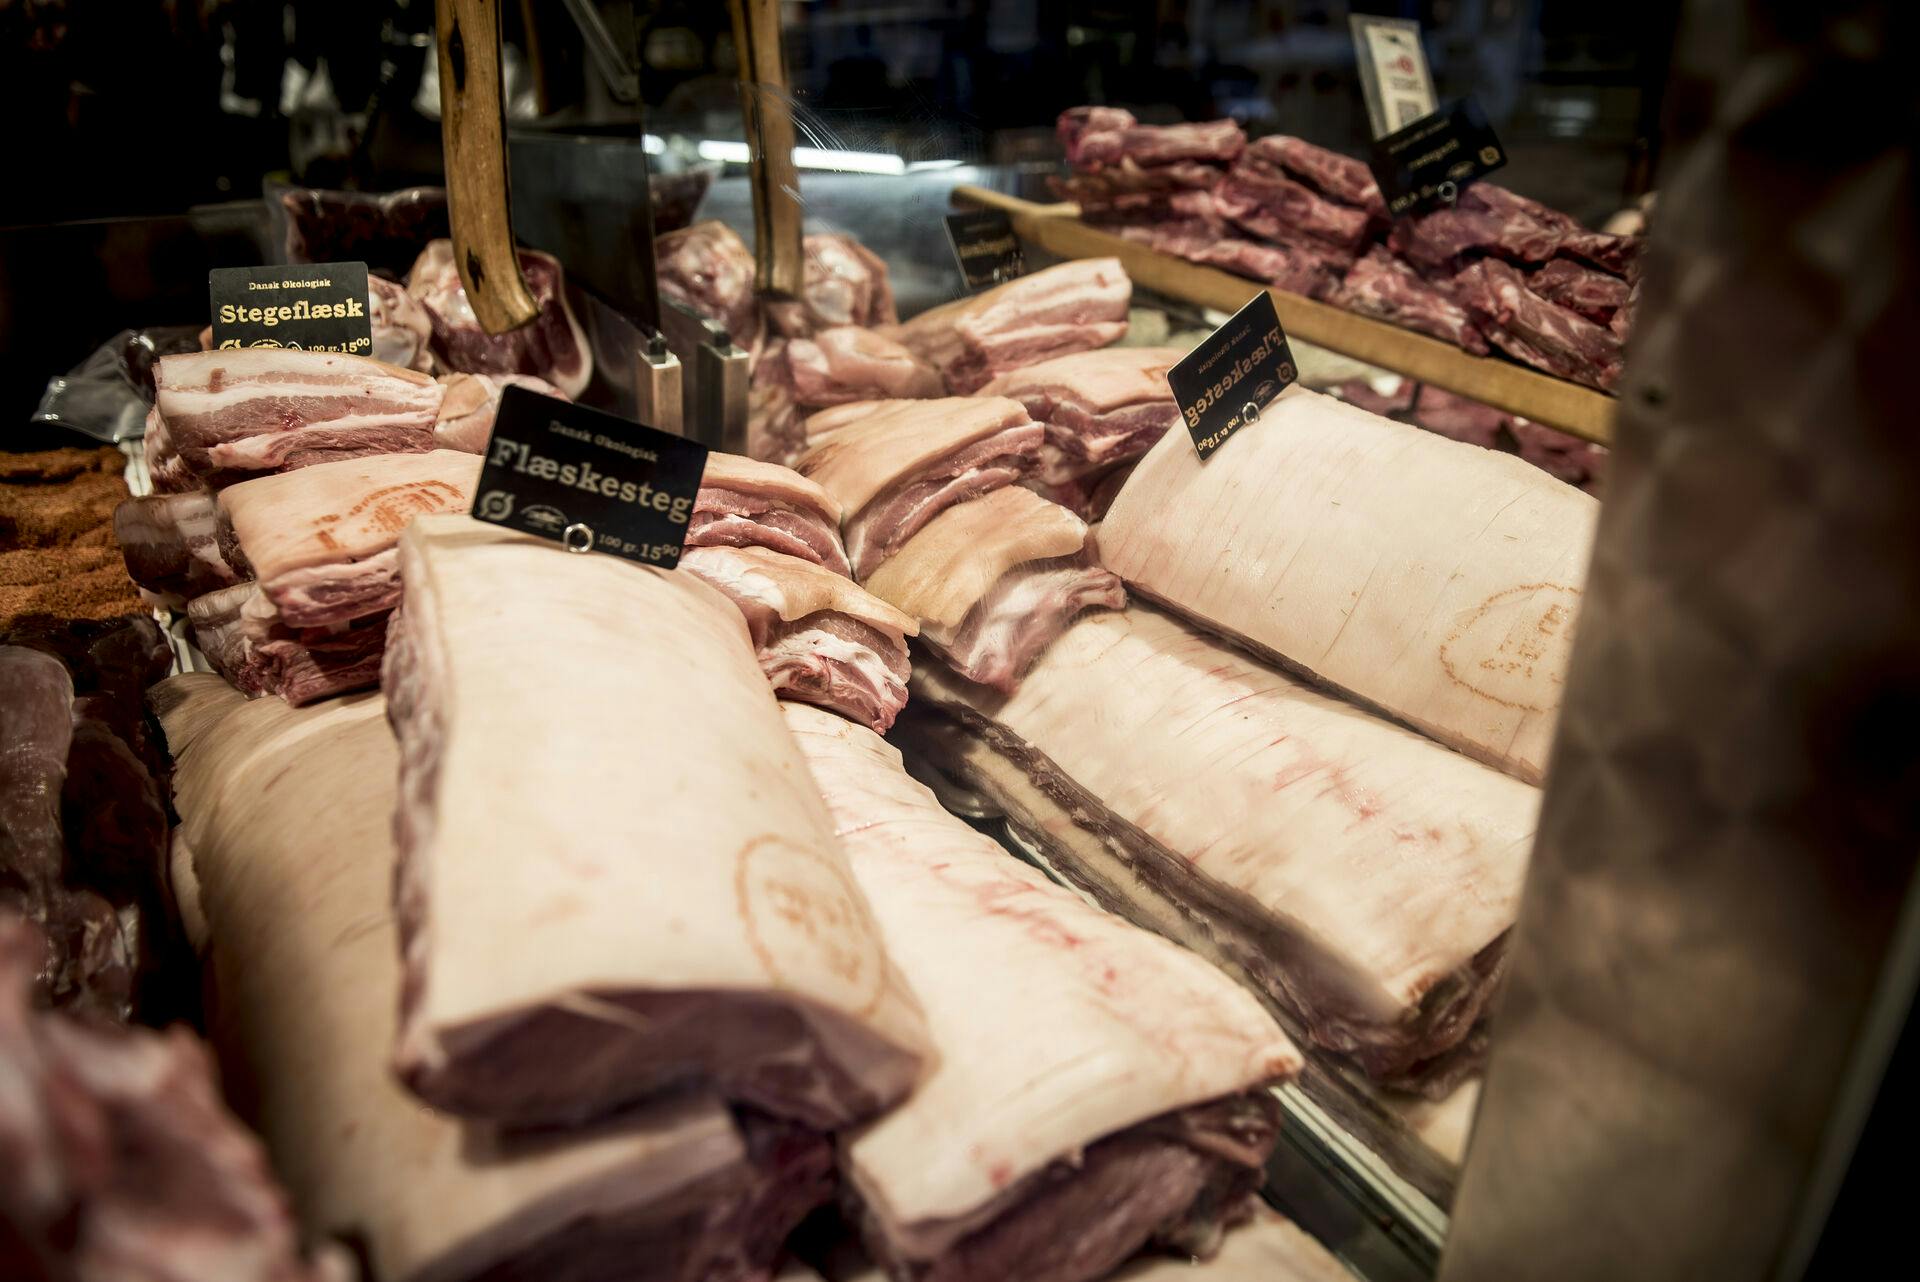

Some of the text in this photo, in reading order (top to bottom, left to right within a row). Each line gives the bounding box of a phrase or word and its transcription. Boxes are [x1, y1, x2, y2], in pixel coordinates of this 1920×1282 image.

[249, 279, 331, 290] Dansk Økologisk
[220, 298, 364, 326] Stegeflæsk
[548, 420, 659, 463] Dansk Økologisk
[489, 436, 692, 524] Flæskesteg
[599, 533, 622, 549] 100
